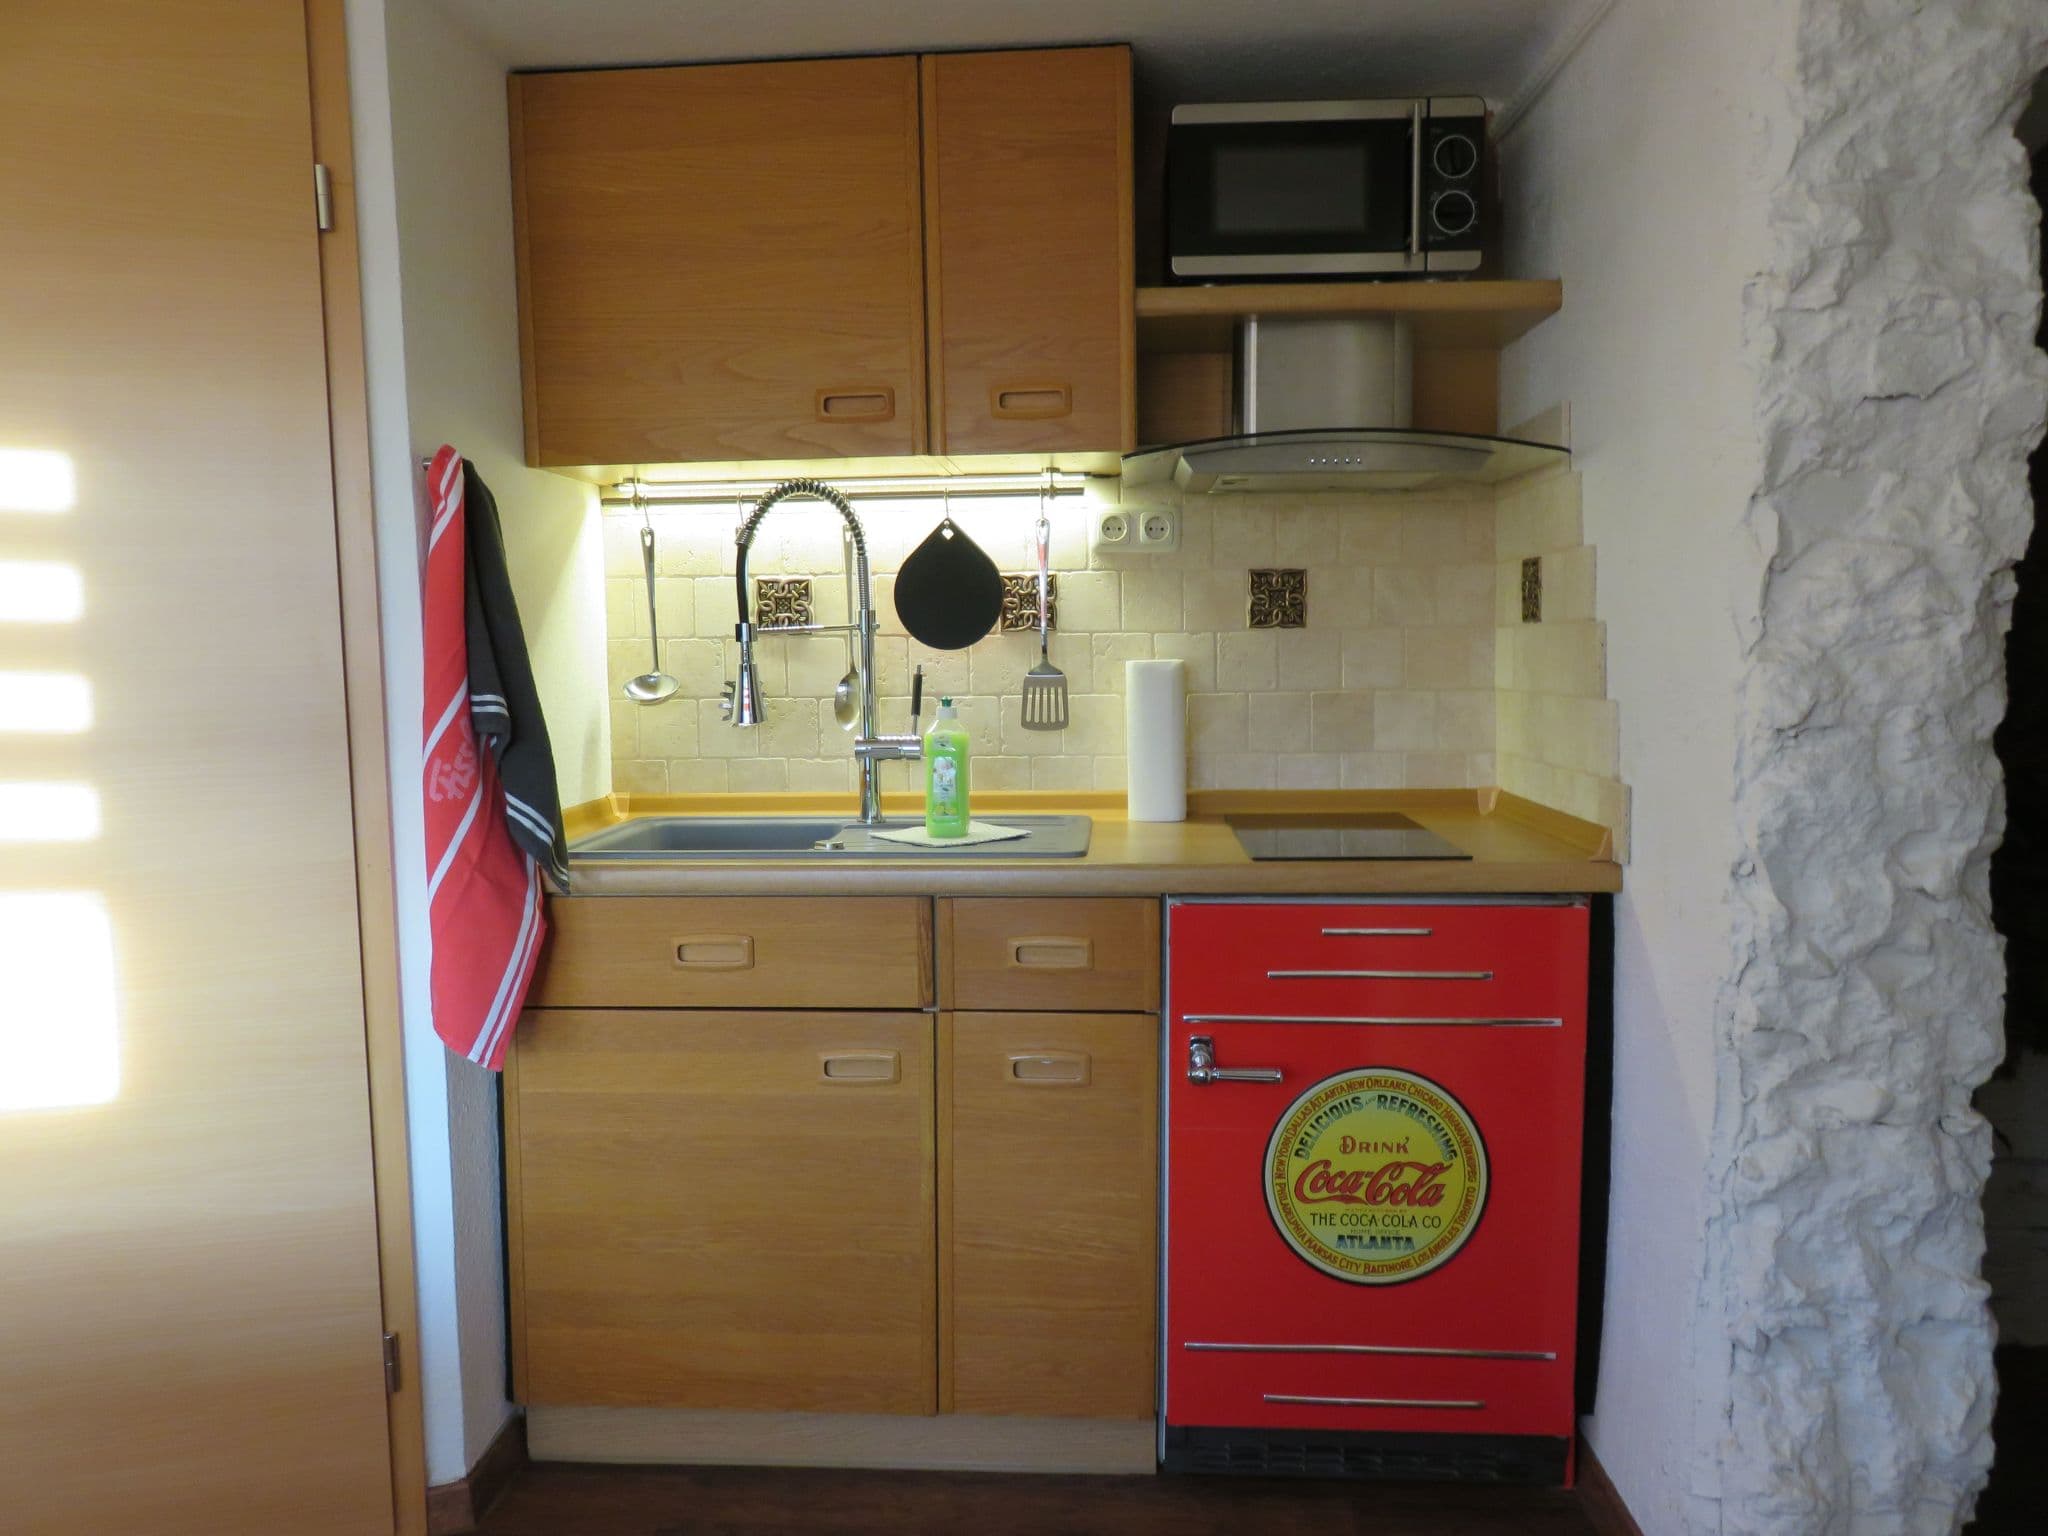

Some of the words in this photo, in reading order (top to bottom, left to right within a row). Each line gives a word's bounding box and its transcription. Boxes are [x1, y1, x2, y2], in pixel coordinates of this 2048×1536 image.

[1345, 1078, 1366, 1091] NEW
[1366, 1077, 1407, 1092] ORLEANS
[1310, 1084, 1346, 1112] ATLANTA
[1407, 1084, 1444, 1110] CHICAGO
[1286, 1105, 1312, 1138] DALLAS
[1294, 1096, 1364, 1161] DELICIOUS
[1376, 1094, 1458, 1162] REFRESHING
[1277, 1134, 1292, 1158] YORK
[1339, 1135, 1409, 1155] DRINK
[1274, 1158, 1286, 1180] NEW
[1294, 1159, 1453, 1207] Coca-Cola
[1275, 1182, 1306, 1239] PHILADELPHIA
[1303, 1236, 1340, 1265] KANSAS
[1338, 1257, 1361, 1273] CITY
[1363, 1259, 1413, 1274] BALTIMORE
[1412, 1253, 1430, 1267] LOS
[1428, 1225, 1460, 1257] ANGELES
[1457, 1186, 1476, 1228] TORONTO
[1310, 1212, 1337, 1227] THE
[1422, 1215, 1442, 1229] CO
[1336, 1234, 1415, 1249] ATLANTA
